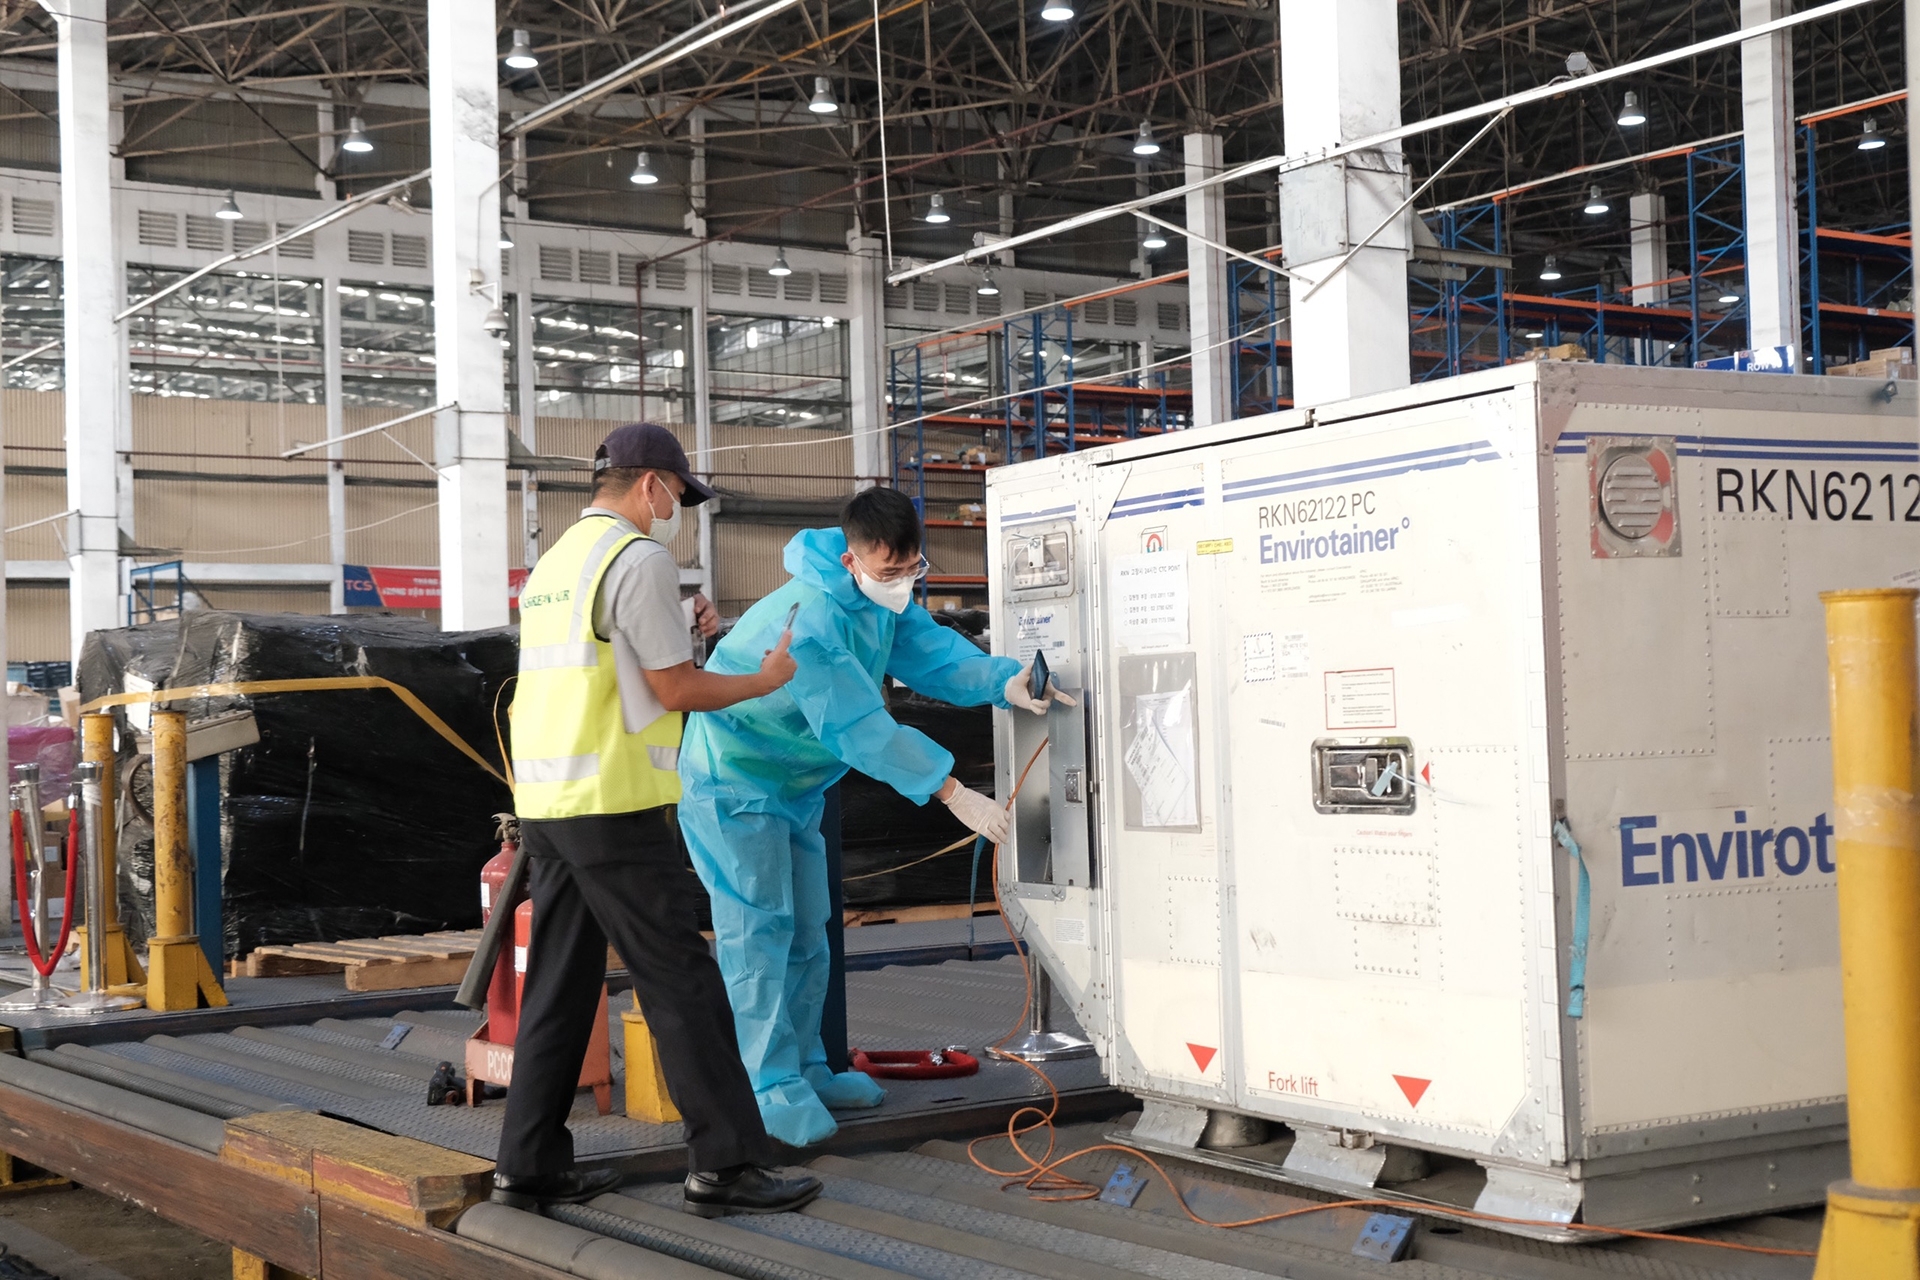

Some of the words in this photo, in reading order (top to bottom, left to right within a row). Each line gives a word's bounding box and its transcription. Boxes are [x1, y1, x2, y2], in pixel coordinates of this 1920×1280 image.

[1258, 494, 1348, 529] RKN62122
[1351, 490, 1376, 517] PC
[345, 579, 373, 591] TCS
[1619, 810, 1837, 888] Envirot
[1268, 1071, 1298, 1095] Fork
[1300, 1076, 1319, 1097] lift
